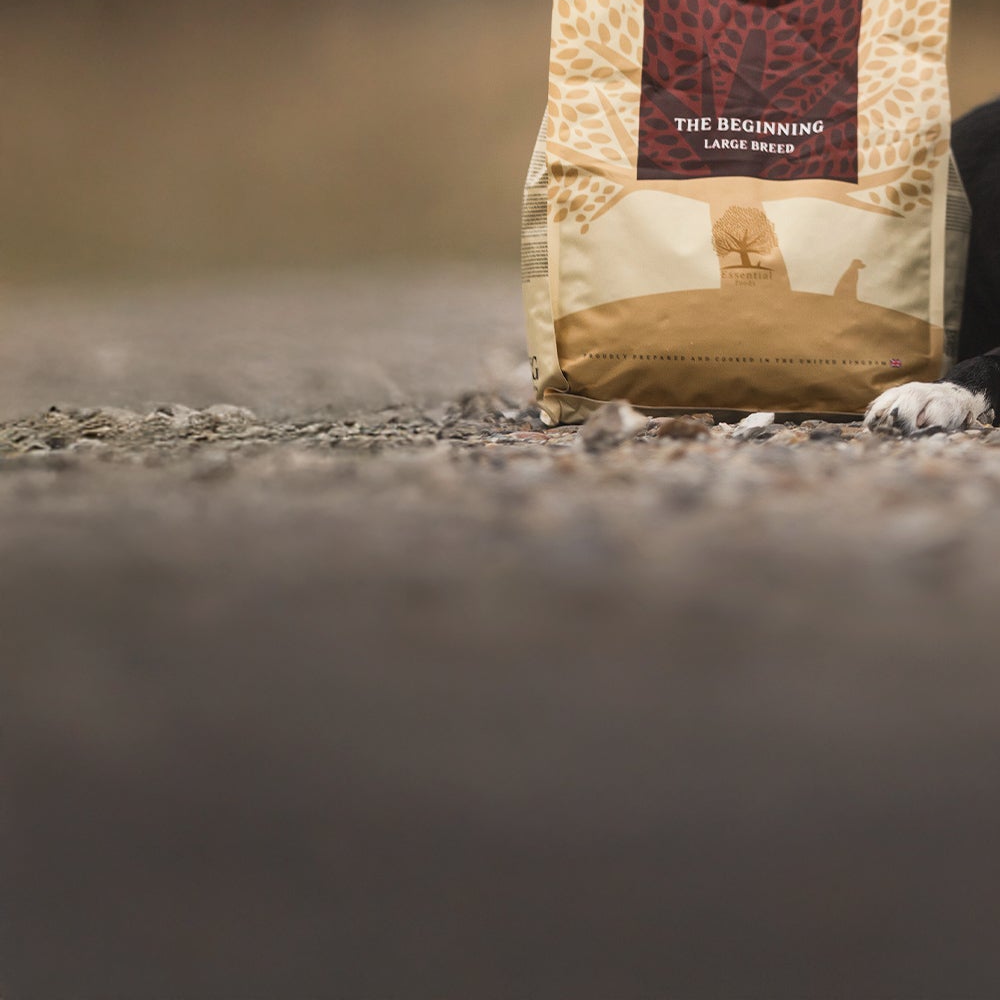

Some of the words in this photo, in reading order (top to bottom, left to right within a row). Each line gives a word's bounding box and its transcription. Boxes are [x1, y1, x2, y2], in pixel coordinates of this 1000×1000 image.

[674, 117, 711, 132] THE
[718, 117, 824, 136] BEGINNING
[704, 139, 748, 150] LARGE
[751, 141, 795, 154] BREED
[721, 271, 772, 280] Essential
